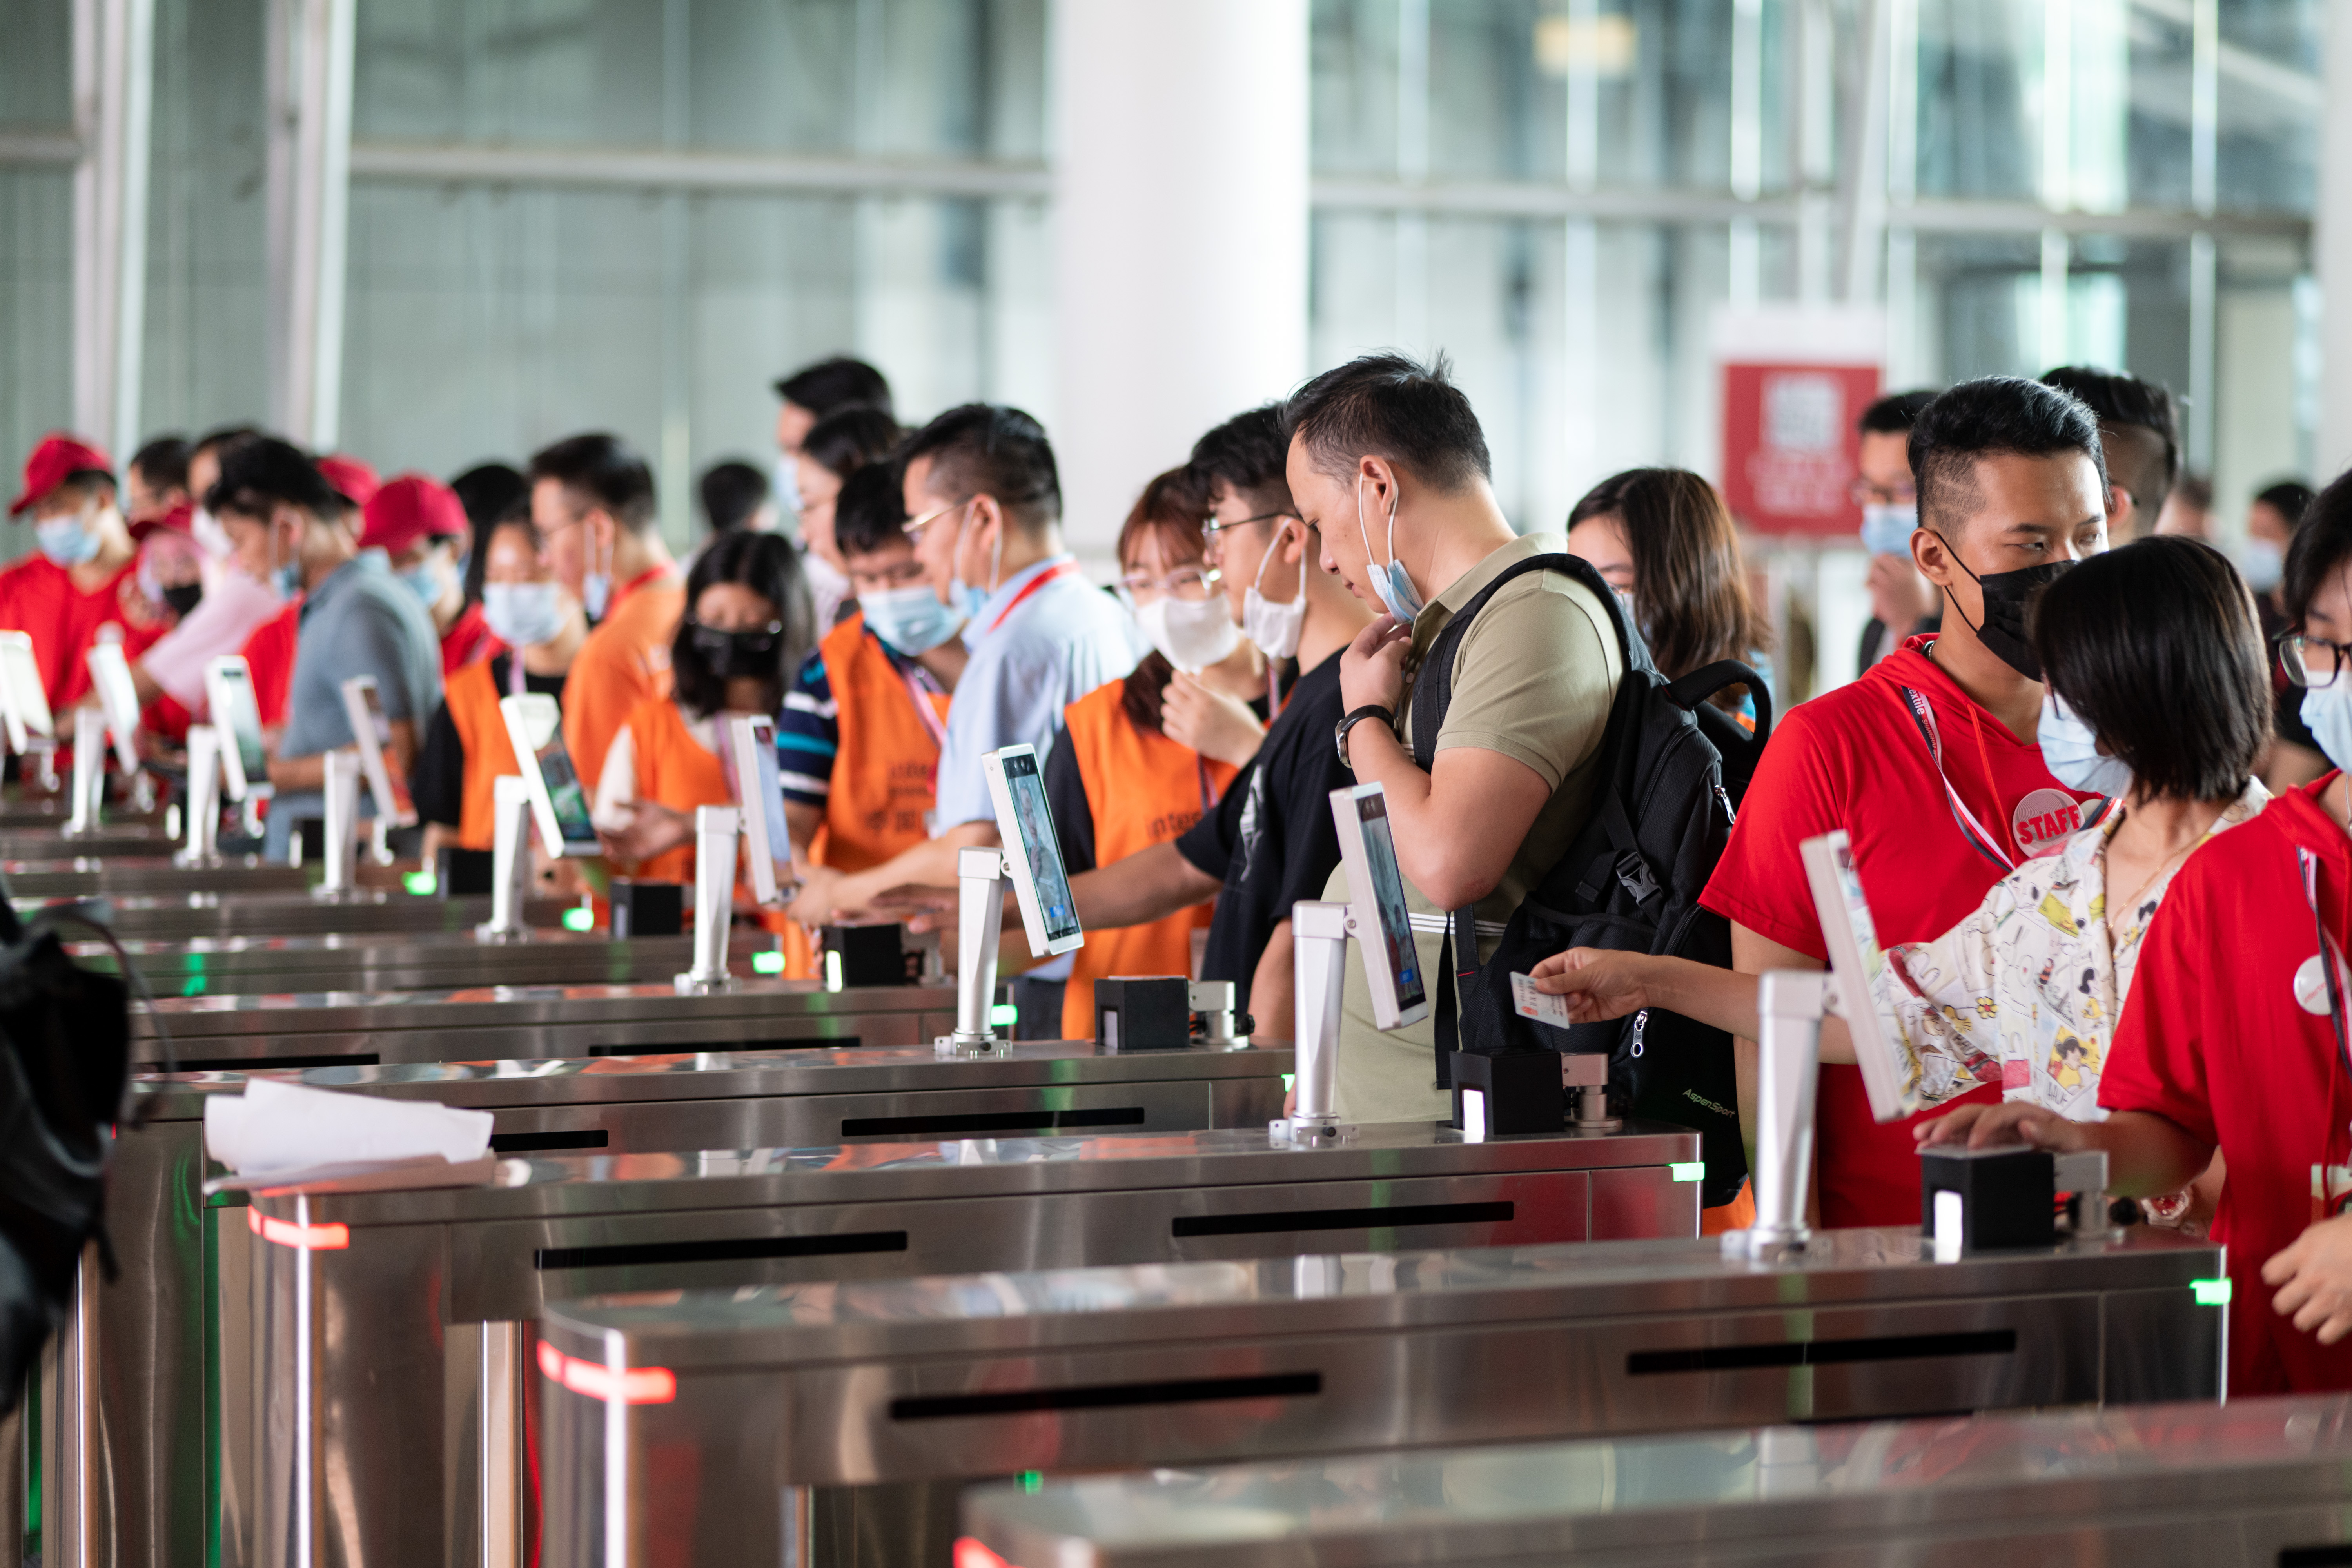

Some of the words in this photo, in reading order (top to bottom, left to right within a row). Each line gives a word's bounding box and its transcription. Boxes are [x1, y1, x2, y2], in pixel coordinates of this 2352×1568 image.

[1907, 688, 1926, 715] extile
[1922, 719, 1936, 748] SHANGHAI
[2016, 804, 2080, 845] STAFF
[1682, 1089, 1735, 1118] AspenSport
